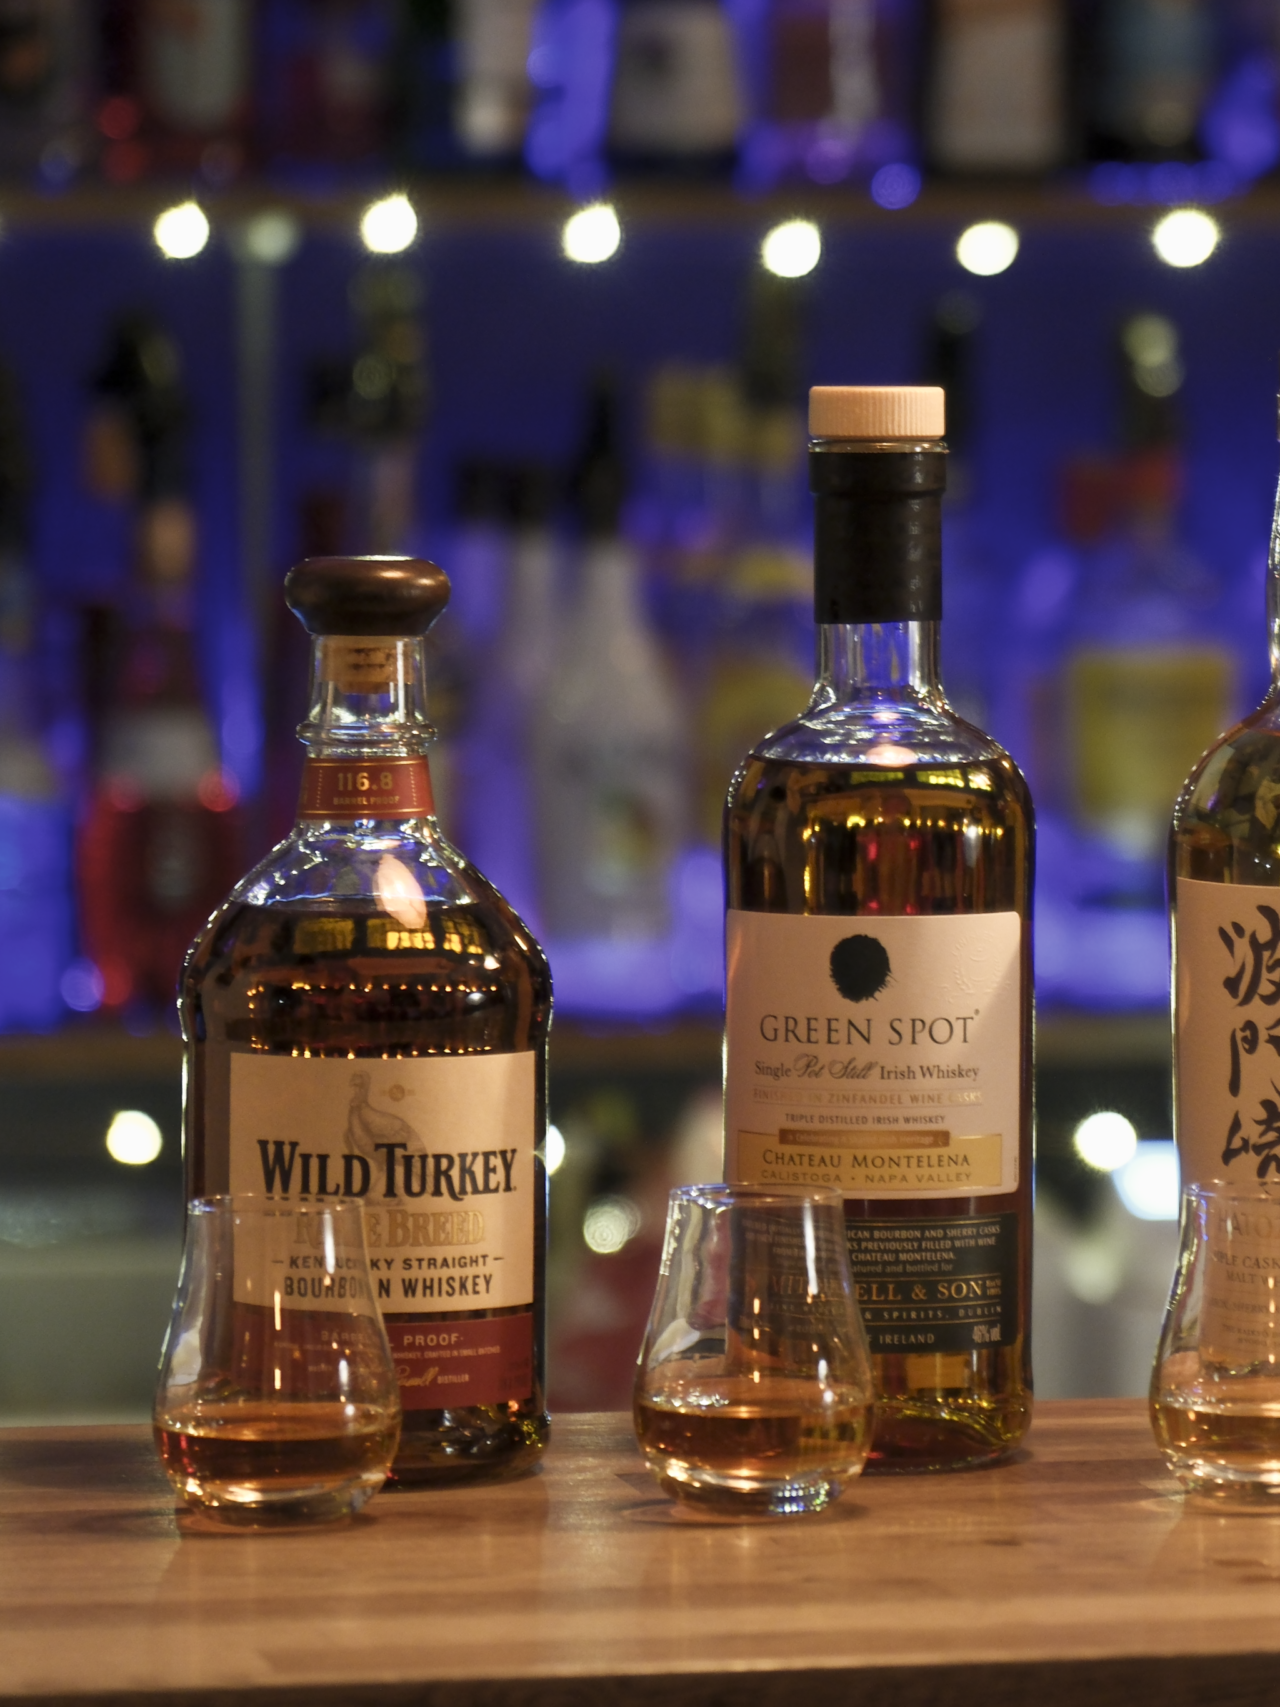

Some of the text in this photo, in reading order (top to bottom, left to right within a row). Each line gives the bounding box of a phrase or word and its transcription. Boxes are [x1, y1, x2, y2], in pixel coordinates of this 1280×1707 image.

[337, 772, 394, 792] 116.8
[759, 1013, 975, 1046] GREEN SPOT
[755, 1060, 792, 1081] Single
[792, 1052, 824, 1081] Pot
[880, 1064, 916, 1081] Irish
[919, 1061, 980, 1083] Whiskey
[828, 1093, 904, 1106] ZINFANDEL
[909, 1093, 943, 1105] WINE
[785, 1112, 946, 1126] TRIPLE DISTILLED IRISH WHISKEY
[762, 1148, 971, 1169] CHATEAU MONTELENA
[256, 1138, 518, 1202] WILD TURKEY
[761, 1169, 972, 1184] CALISTOGA NAPA VALLEY
[385, 1207, 487, 1250] BREED
[873, 1229, 921, 1240] BOURBON
[924, 1229, 944, 1238] AND
[946, 1227, 977, 1237] SHERRY
[979, 1224, 1000, 1235] CASKS
[861, 1240, 918, 1251] PREVIOUSLY
[921, 1240, 951, 1250] FILLED
[953, 1238, 976, 1249] WITH
[977, 1236, 997, 1247] WINE
[288, 1253, 489, 1273] KENUCKY STRAIGHT
[851, 1252, 896, 1262] CHATEAU
[906, 1262, 939, 1273] bottled
[1226, 1270, 1258, 1285] MALT
[402, 1272, 494, 1299] WHISKEY
[911, 1283, 928, 1300] &
[937, 1280, 983, 1299] SON
[958, 1305, 1001, 1317] DUBLIN
[403, 1333, 460, 1347] PROOF
[879, 1332, 935, 1344] IRELAND
